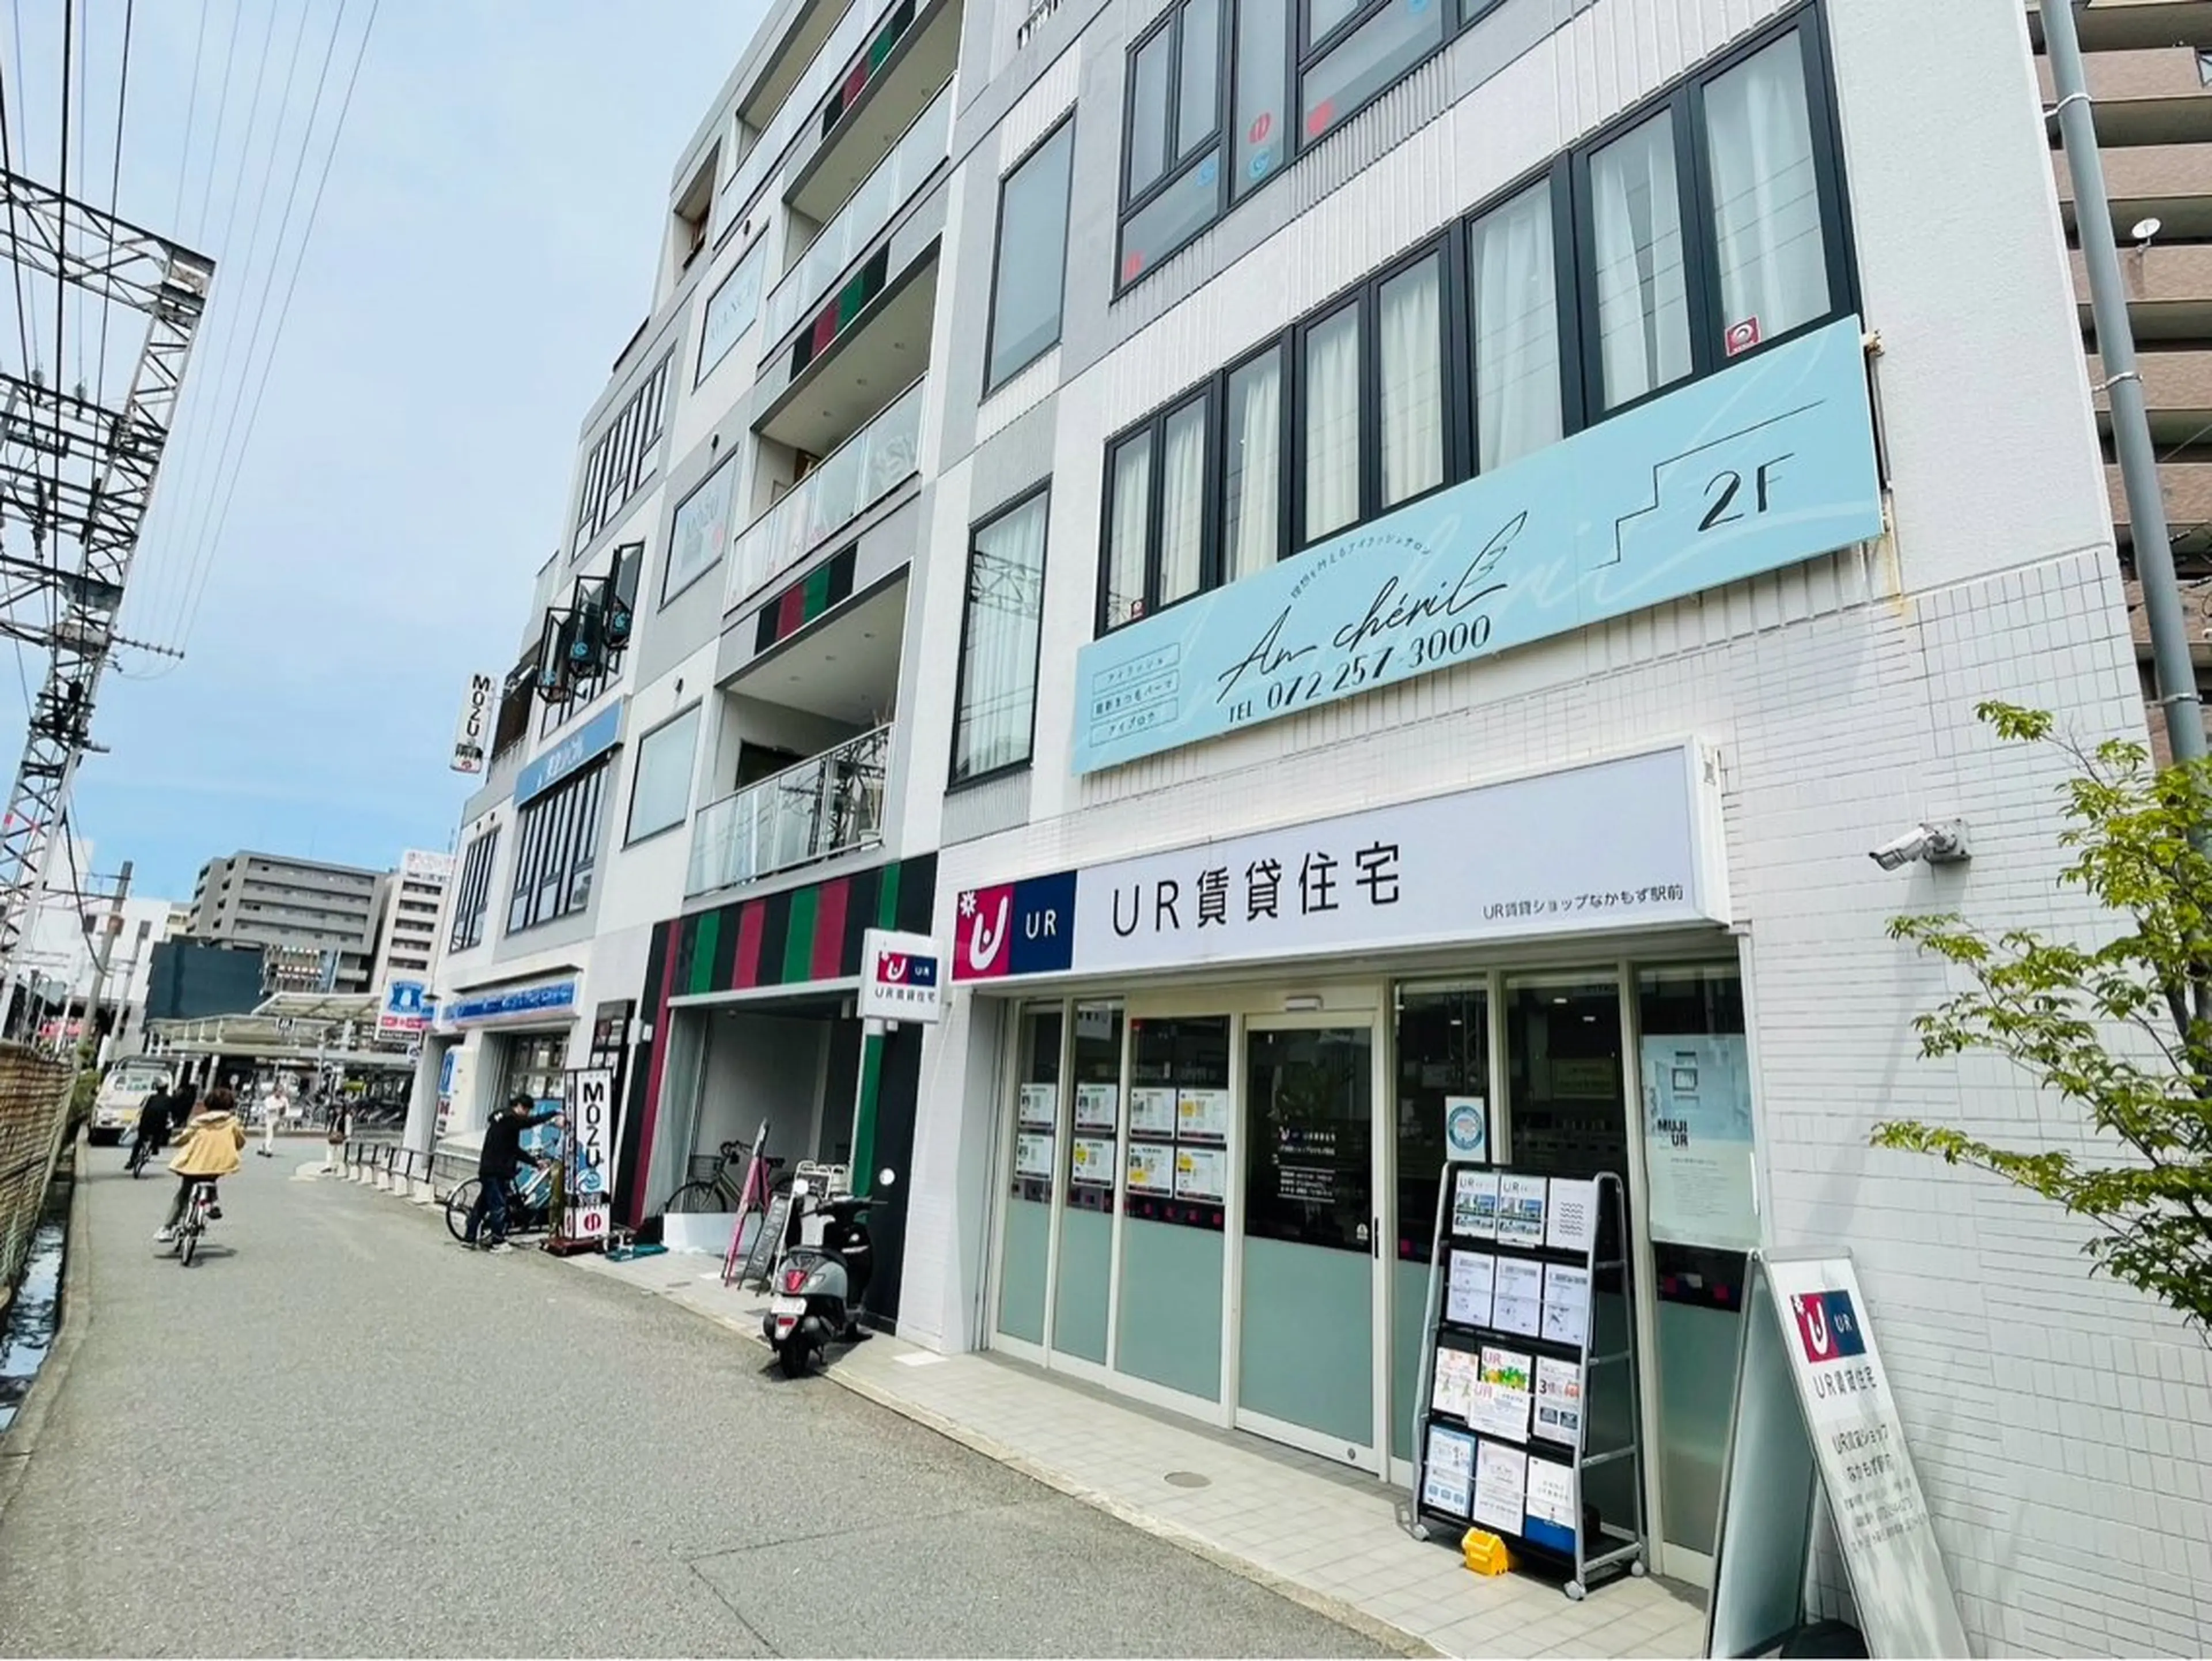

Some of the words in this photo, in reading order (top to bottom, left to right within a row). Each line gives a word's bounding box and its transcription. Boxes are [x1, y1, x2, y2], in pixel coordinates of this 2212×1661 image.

[1698, 453, 1794, 531] 2F
[467, 674, 491, 737] MOZU
[1229, 703, 1254, 723] TEL
[1112, 840, 1400, 937] UR賃貸住宅
[1483, 883, 1684, 920] UR賃貸ショップなかもず駅前
[1025, 909, 1057, 940] UR
[583, 1082, 604, 1168] MOZU
[1657, 1118, 1688, 1133] MUJI
[1671, 1133, 1688, 1147] UR
[1834, 1313, 1853, 1334] UR
